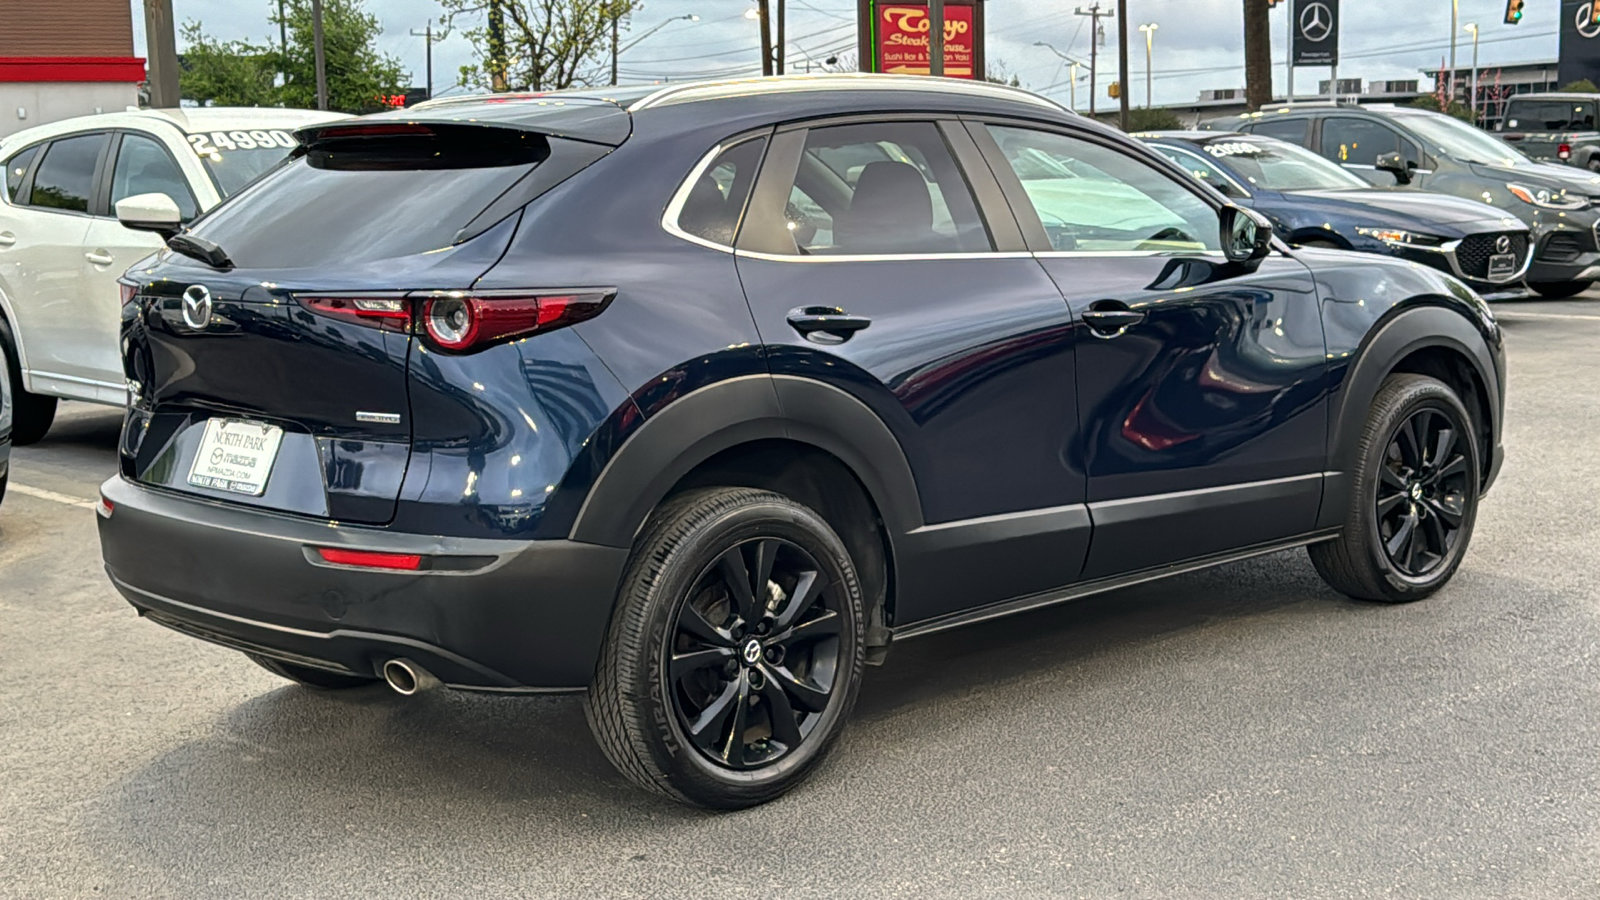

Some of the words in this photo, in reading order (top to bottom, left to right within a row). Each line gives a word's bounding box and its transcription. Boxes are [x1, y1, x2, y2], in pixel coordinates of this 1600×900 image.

[883, 8, 968, 41] Toyo
[884, 52, 902, 60] Sushi
[187, 130, 297, 155] 24990
[213, 430, 244, 448] NORTH
[243, 435, 268, 451] PARK
[223, 452, 257, 468] mazda
[839, 555, 865, 684] BRIDGESTONE
[649, 624, 679, 758] TURANZA
